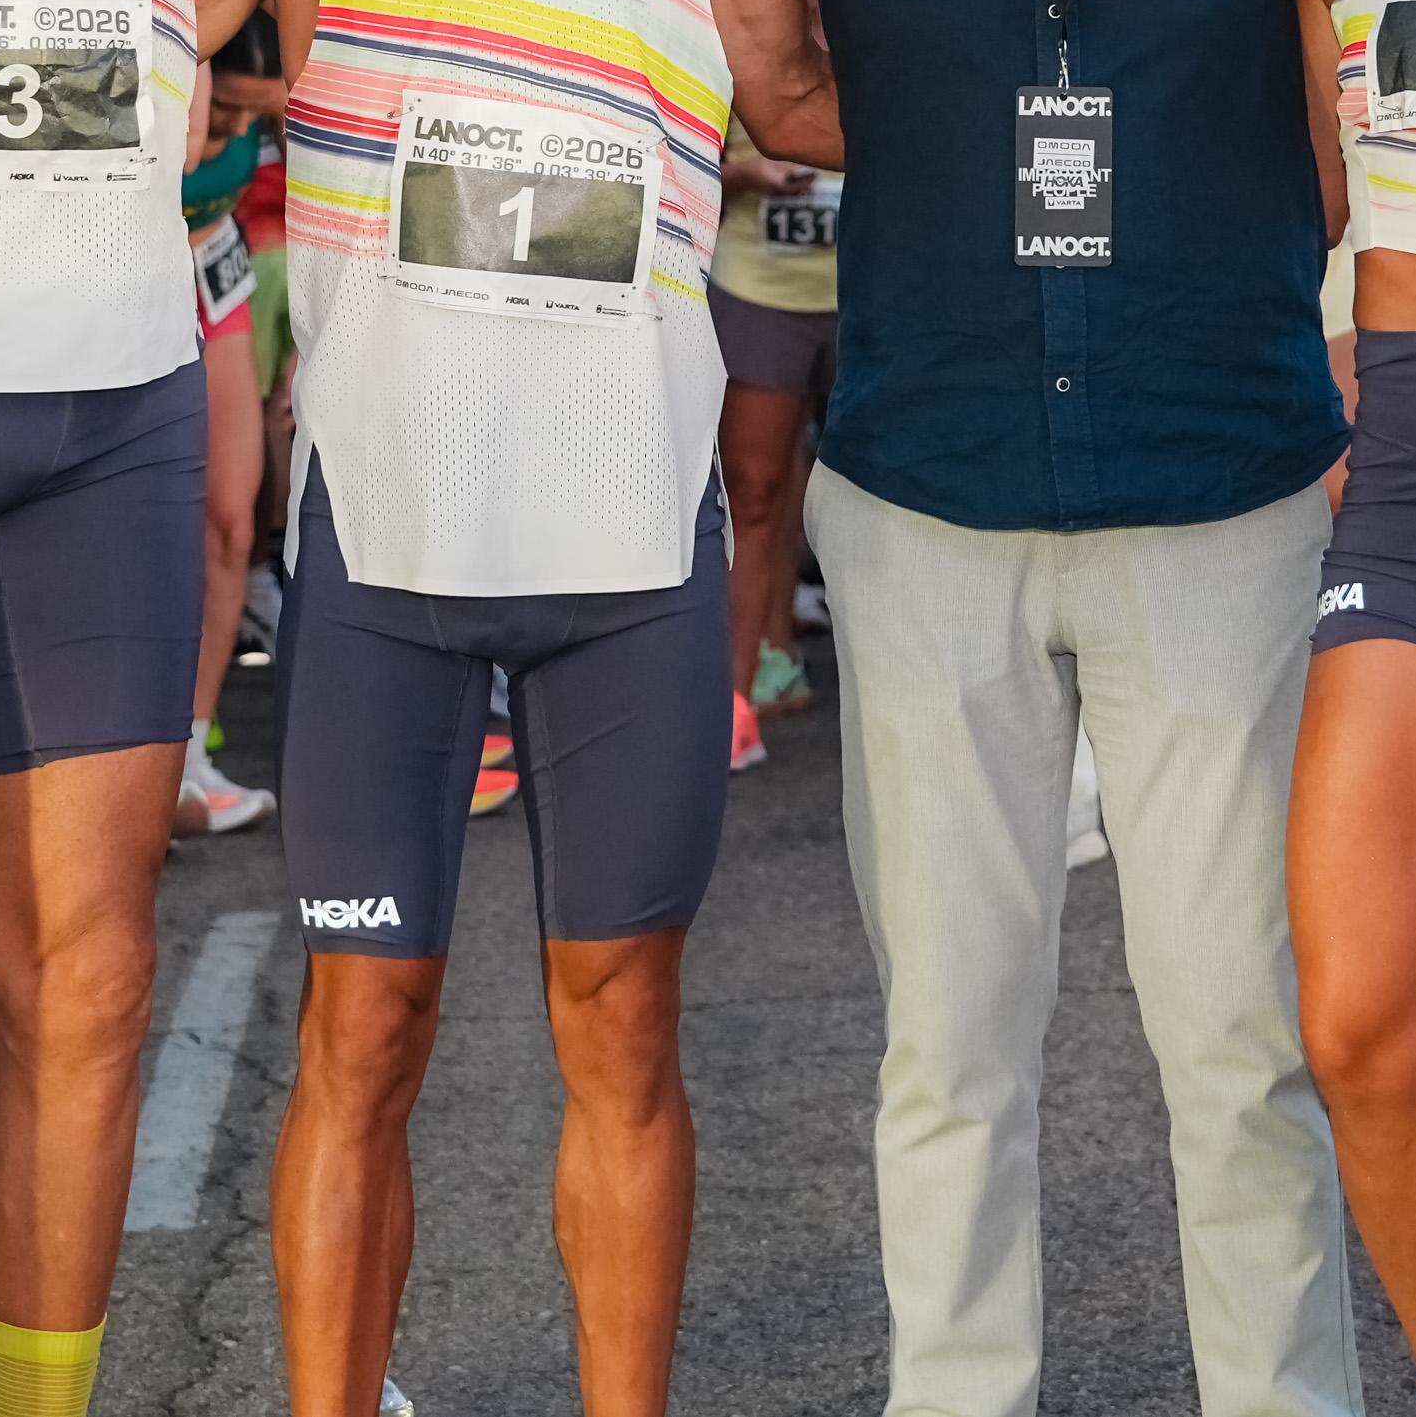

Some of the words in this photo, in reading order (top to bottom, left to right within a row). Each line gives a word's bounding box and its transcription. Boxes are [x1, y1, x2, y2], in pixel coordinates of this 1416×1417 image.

[34, 6, 130, 34] ©2026
[1018, 95, 1112, 117] LANOCT.
[412, 145, 425, 158] N
[428, 147, 456, 162] 40°
[414, 116, 523, 153] LANOCT.
[540, 134, 643, 170] ©2026
[1037, 141, 1091, 151] OMODA
[1037, 158, 1091, 168] JAECOO
[9, 172, 35, 181] HOKA
[1044, 175, 1084, 187] HOKA
[499, 186, 535, 262] 1
[1017, 236, 1111, 257] LANOCT.
[441, 288, 490, 301] JAECOO
[505, 295, 530, 306] HOKA
[554, 302, 581, 311] VARTA
